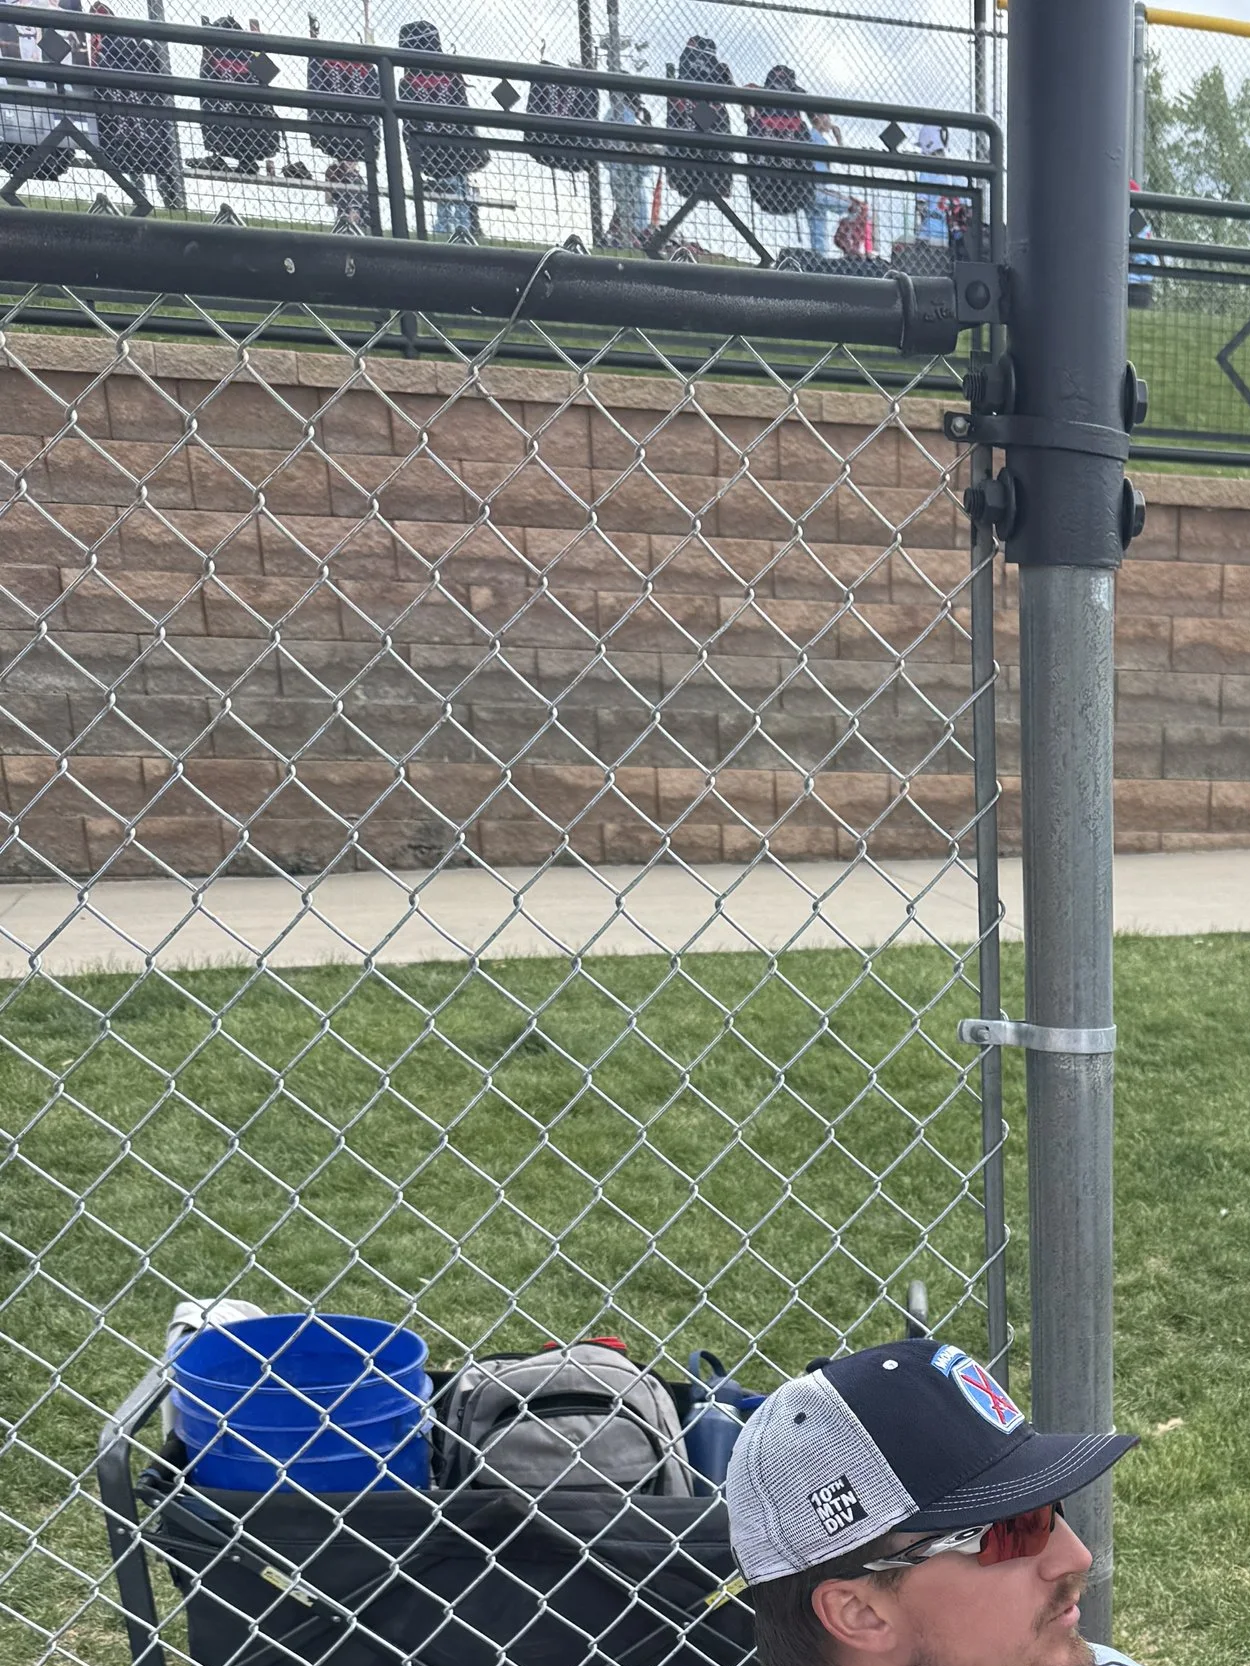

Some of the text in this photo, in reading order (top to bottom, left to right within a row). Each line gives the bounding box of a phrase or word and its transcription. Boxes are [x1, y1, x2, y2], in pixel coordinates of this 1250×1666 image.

[811, 1479, 845, 1507] 10TH
[816, 1490, 857, 1521] MTN
[823, 1507, 854, 1534] DIV
